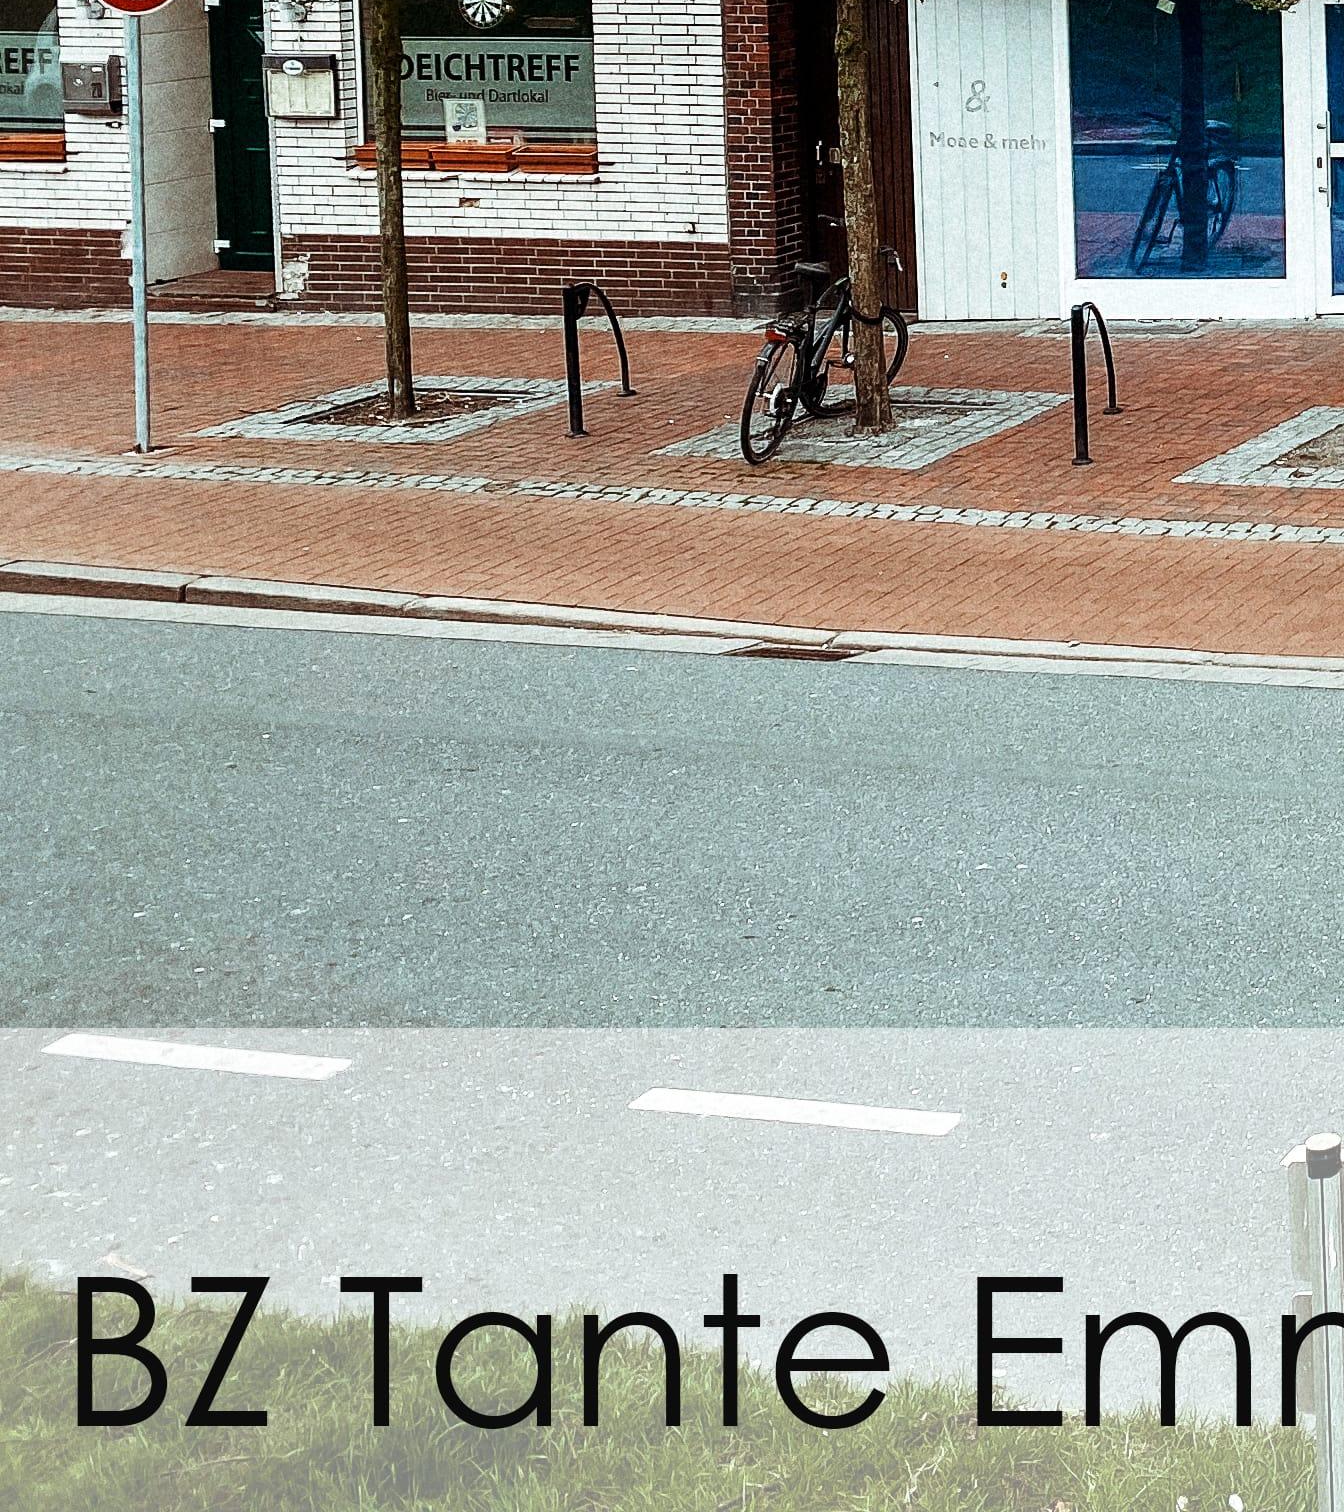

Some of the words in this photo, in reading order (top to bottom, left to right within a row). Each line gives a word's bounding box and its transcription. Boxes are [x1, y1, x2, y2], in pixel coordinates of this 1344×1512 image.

[400, 53, 580, 82] DEICHTREFF
[427, 88, 457, 102] Bier-
[488, 88, 549, 103] Dartlokal
